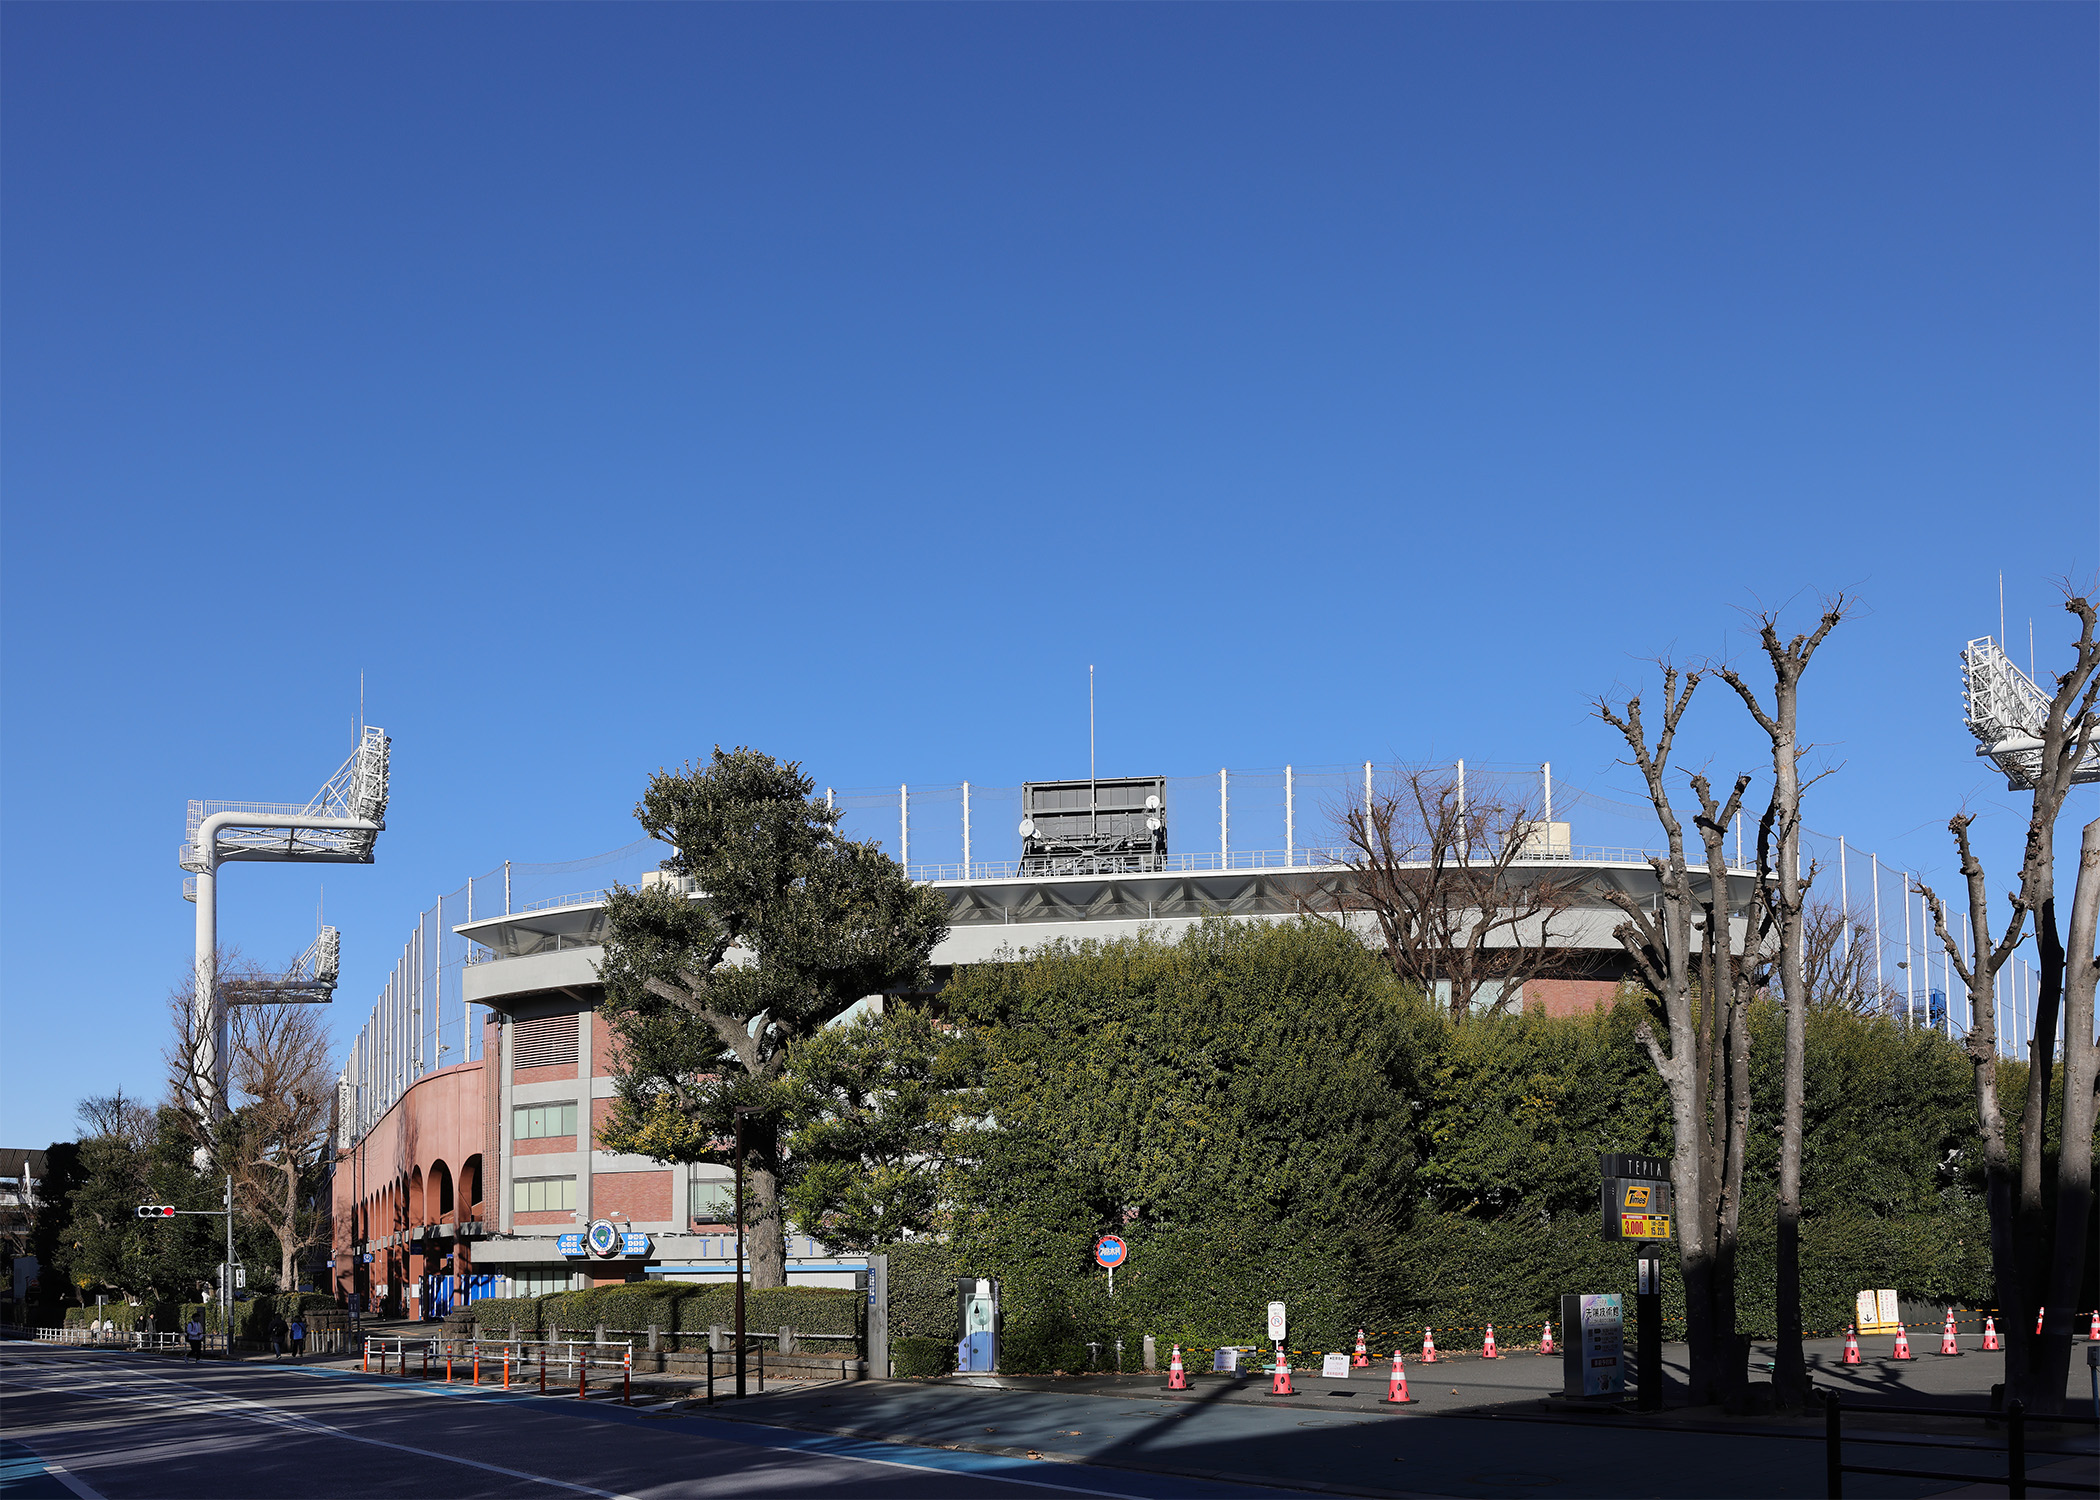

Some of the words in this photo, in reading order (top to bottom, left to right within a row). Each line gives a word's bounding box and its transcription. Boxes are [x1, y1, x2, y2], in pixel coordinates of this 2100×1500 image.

[1628, 1160, 1662, 1177] TEPIA
[1629, 1193, 1647, 1205] Times
[699, 1238, 816, 1258] TICET
